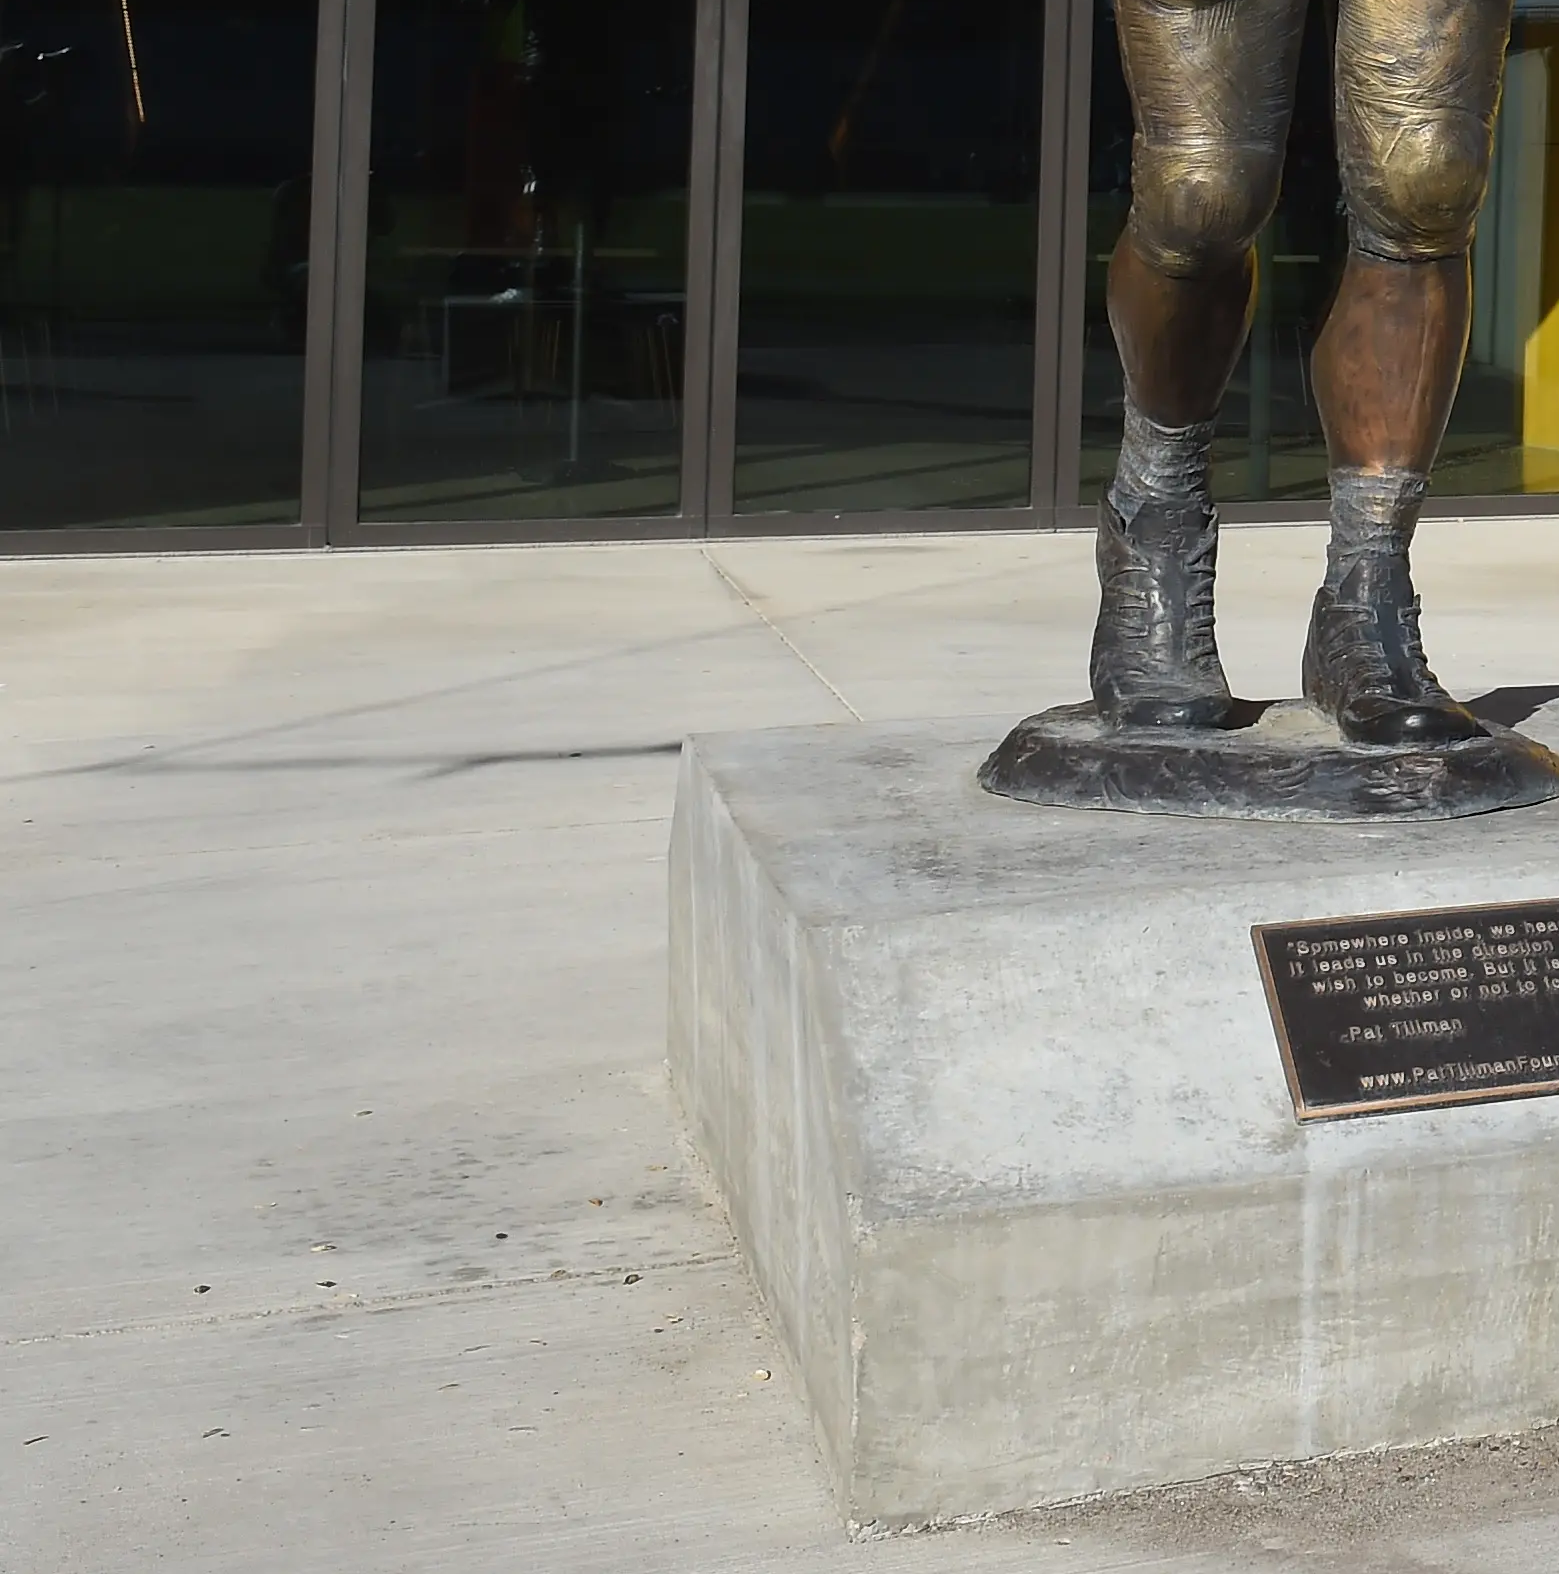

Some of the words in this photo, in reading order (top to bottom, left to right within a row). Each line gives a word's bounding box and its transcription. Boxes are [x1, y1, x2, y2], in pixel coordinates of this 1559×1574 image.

[1490, 924, 1516, 938] we
[1289, 960, 1305, 976] It
[1313, 955, 1366, 974] leads
[1375, 953, 1398, 967] us
[1406, 949, 1424, 965] in
[1431, 946, 1463, 962] the
[1472, 937, 1554, 959] direction
[1312, 975, 1357, 994] wish
[1365, 974, 1385, 988] to
[1393, 965, 1475, 986] become.
[1483, 960, 1516, 977] But
[1363, 988, 1441, 1009] whether
[1450, 984, 1470, 1001] or
[1478, 979, 1509, 996] not
[1517, 978, 1536, 993] to
[1391, 1017, 1463, 1040] Tillman
